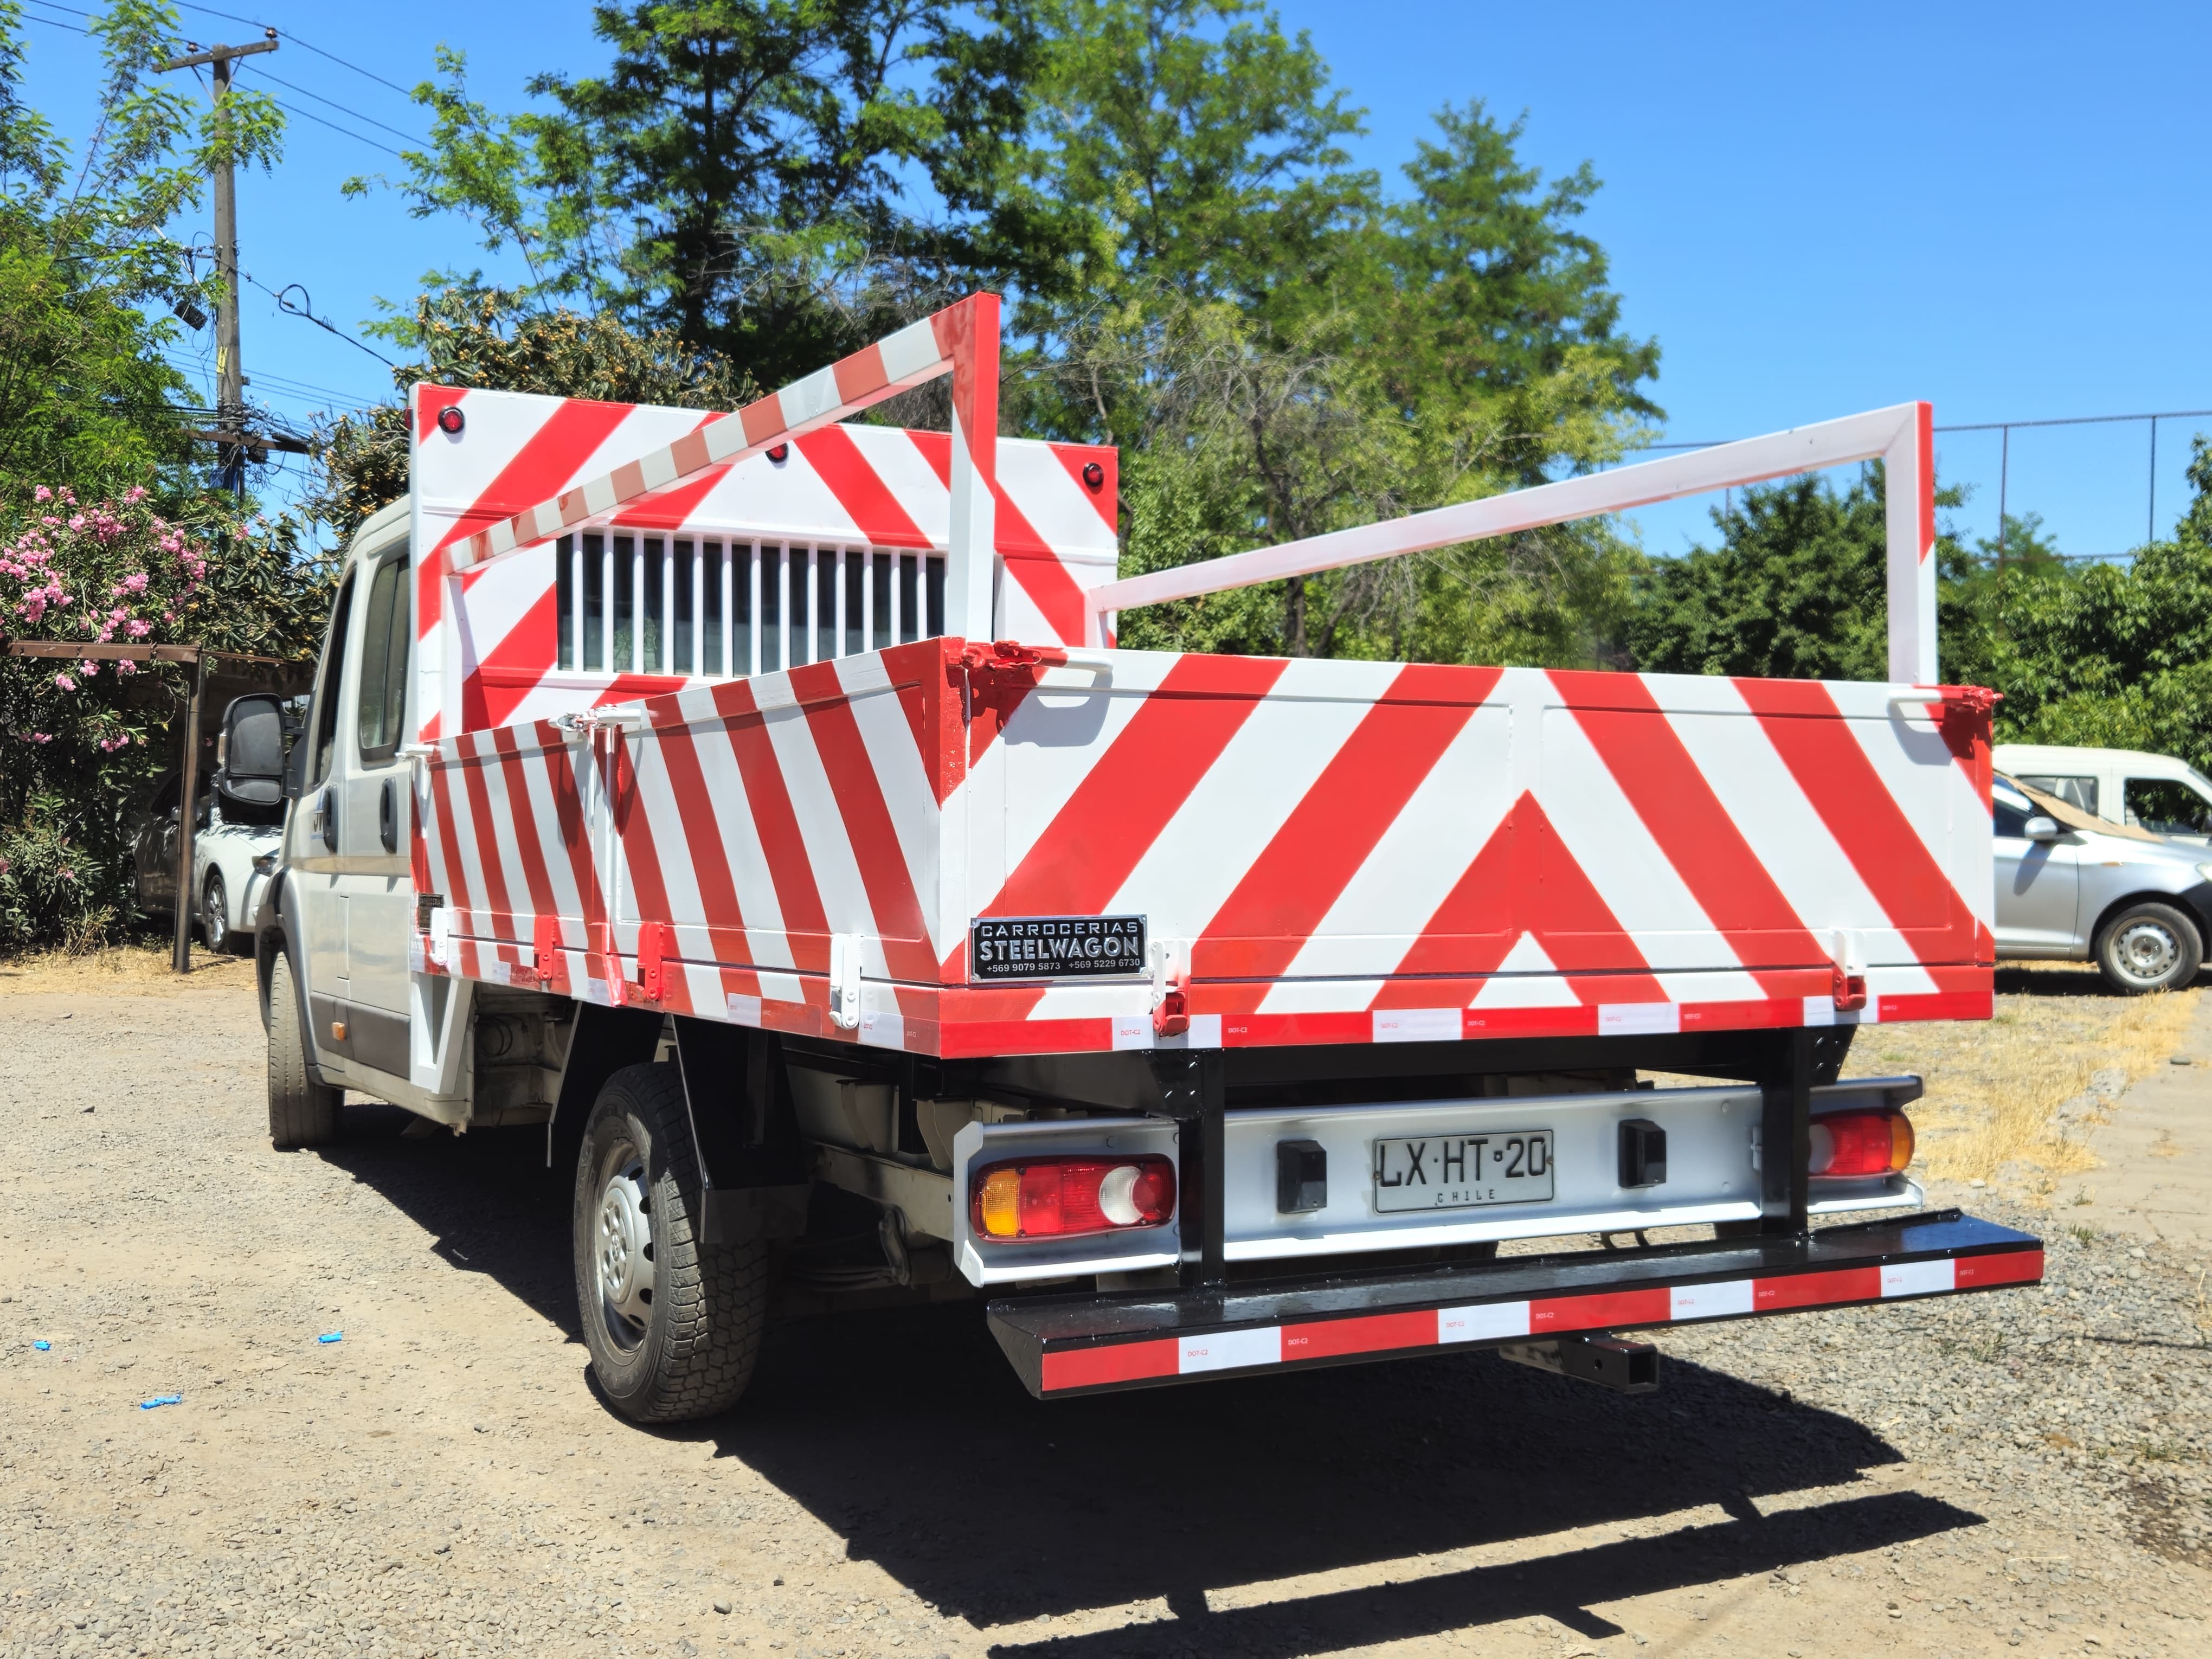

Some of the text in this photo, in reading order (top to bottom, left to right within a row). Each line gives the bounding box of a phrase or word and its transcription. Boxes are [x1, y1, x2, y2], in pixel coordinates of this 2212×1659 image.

[980, 922, 1137, 937] CARROCERIAS
[979, 936, 1139, 961] STEELWAGON
[986, 958, 1141, 973] +569 9079 5873 +569 5229 6730
[1436, 1189, 1495, 1203] CHILE
